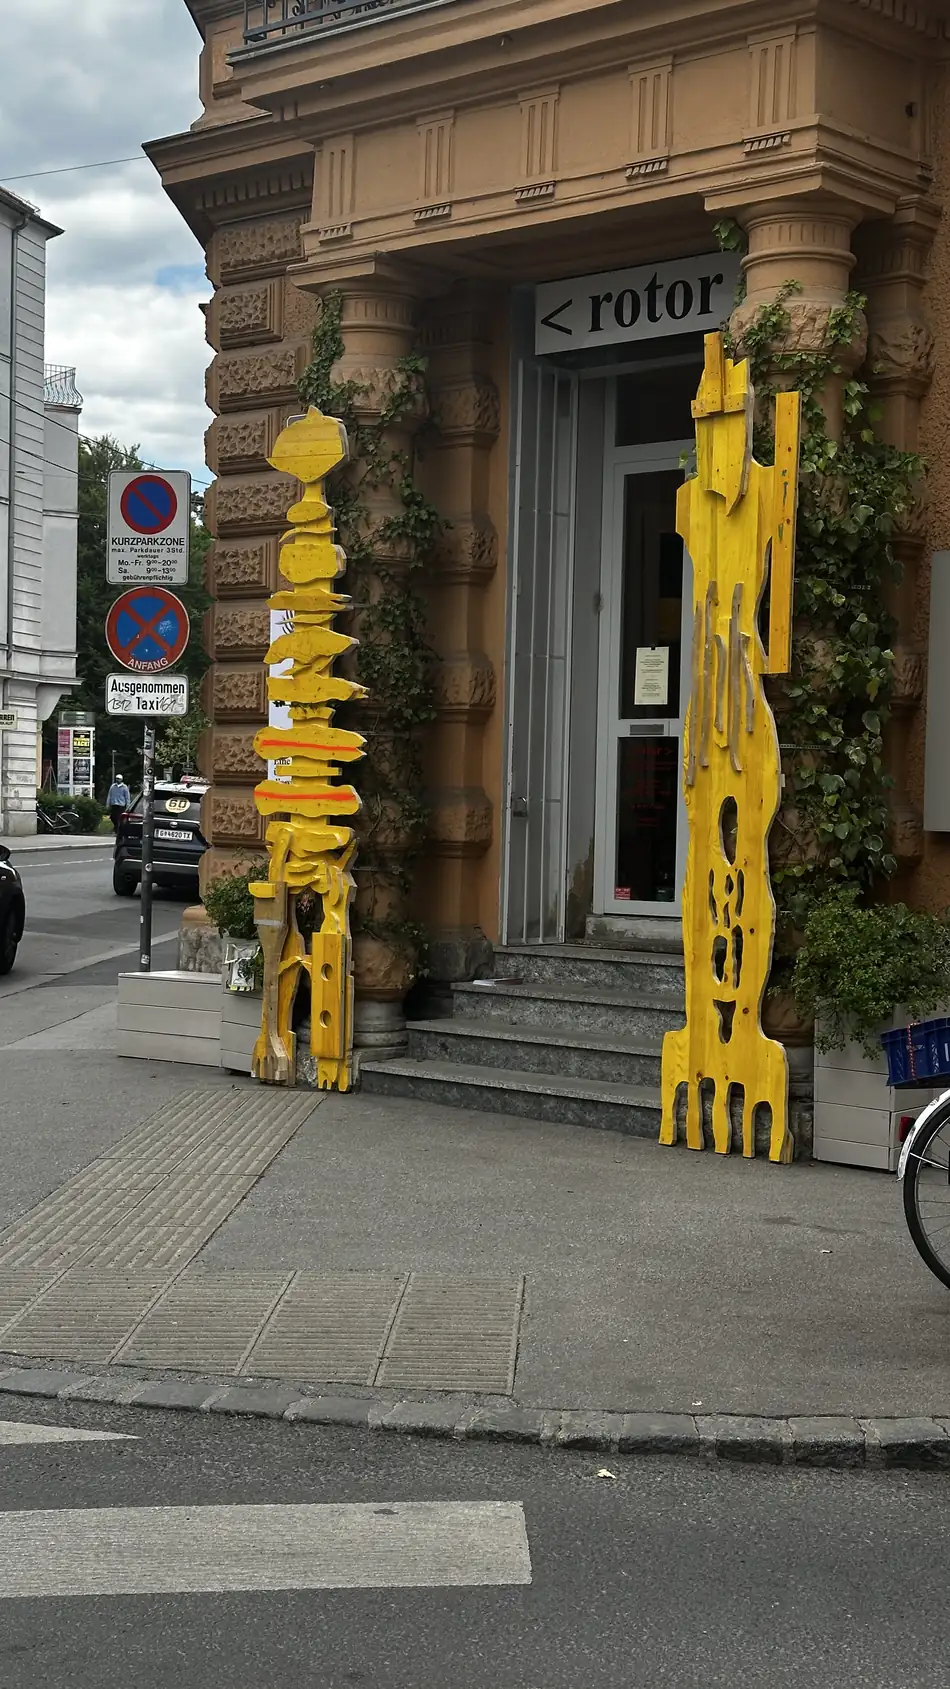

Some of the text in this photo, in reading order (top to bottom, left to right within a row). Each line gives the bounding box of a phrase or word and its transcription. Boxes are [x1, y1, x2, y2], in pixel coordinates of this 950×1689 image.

[588, 271, 723, 333] rotor
[111, 537, 185, 546] KURZPARKZONE
[127, 657, 169, 670] ANFANG
[110, 678, 185, 696] Ausgenommen
[135, 696, 159, 711] Taxi
[168, 799, 188, 809] 60
